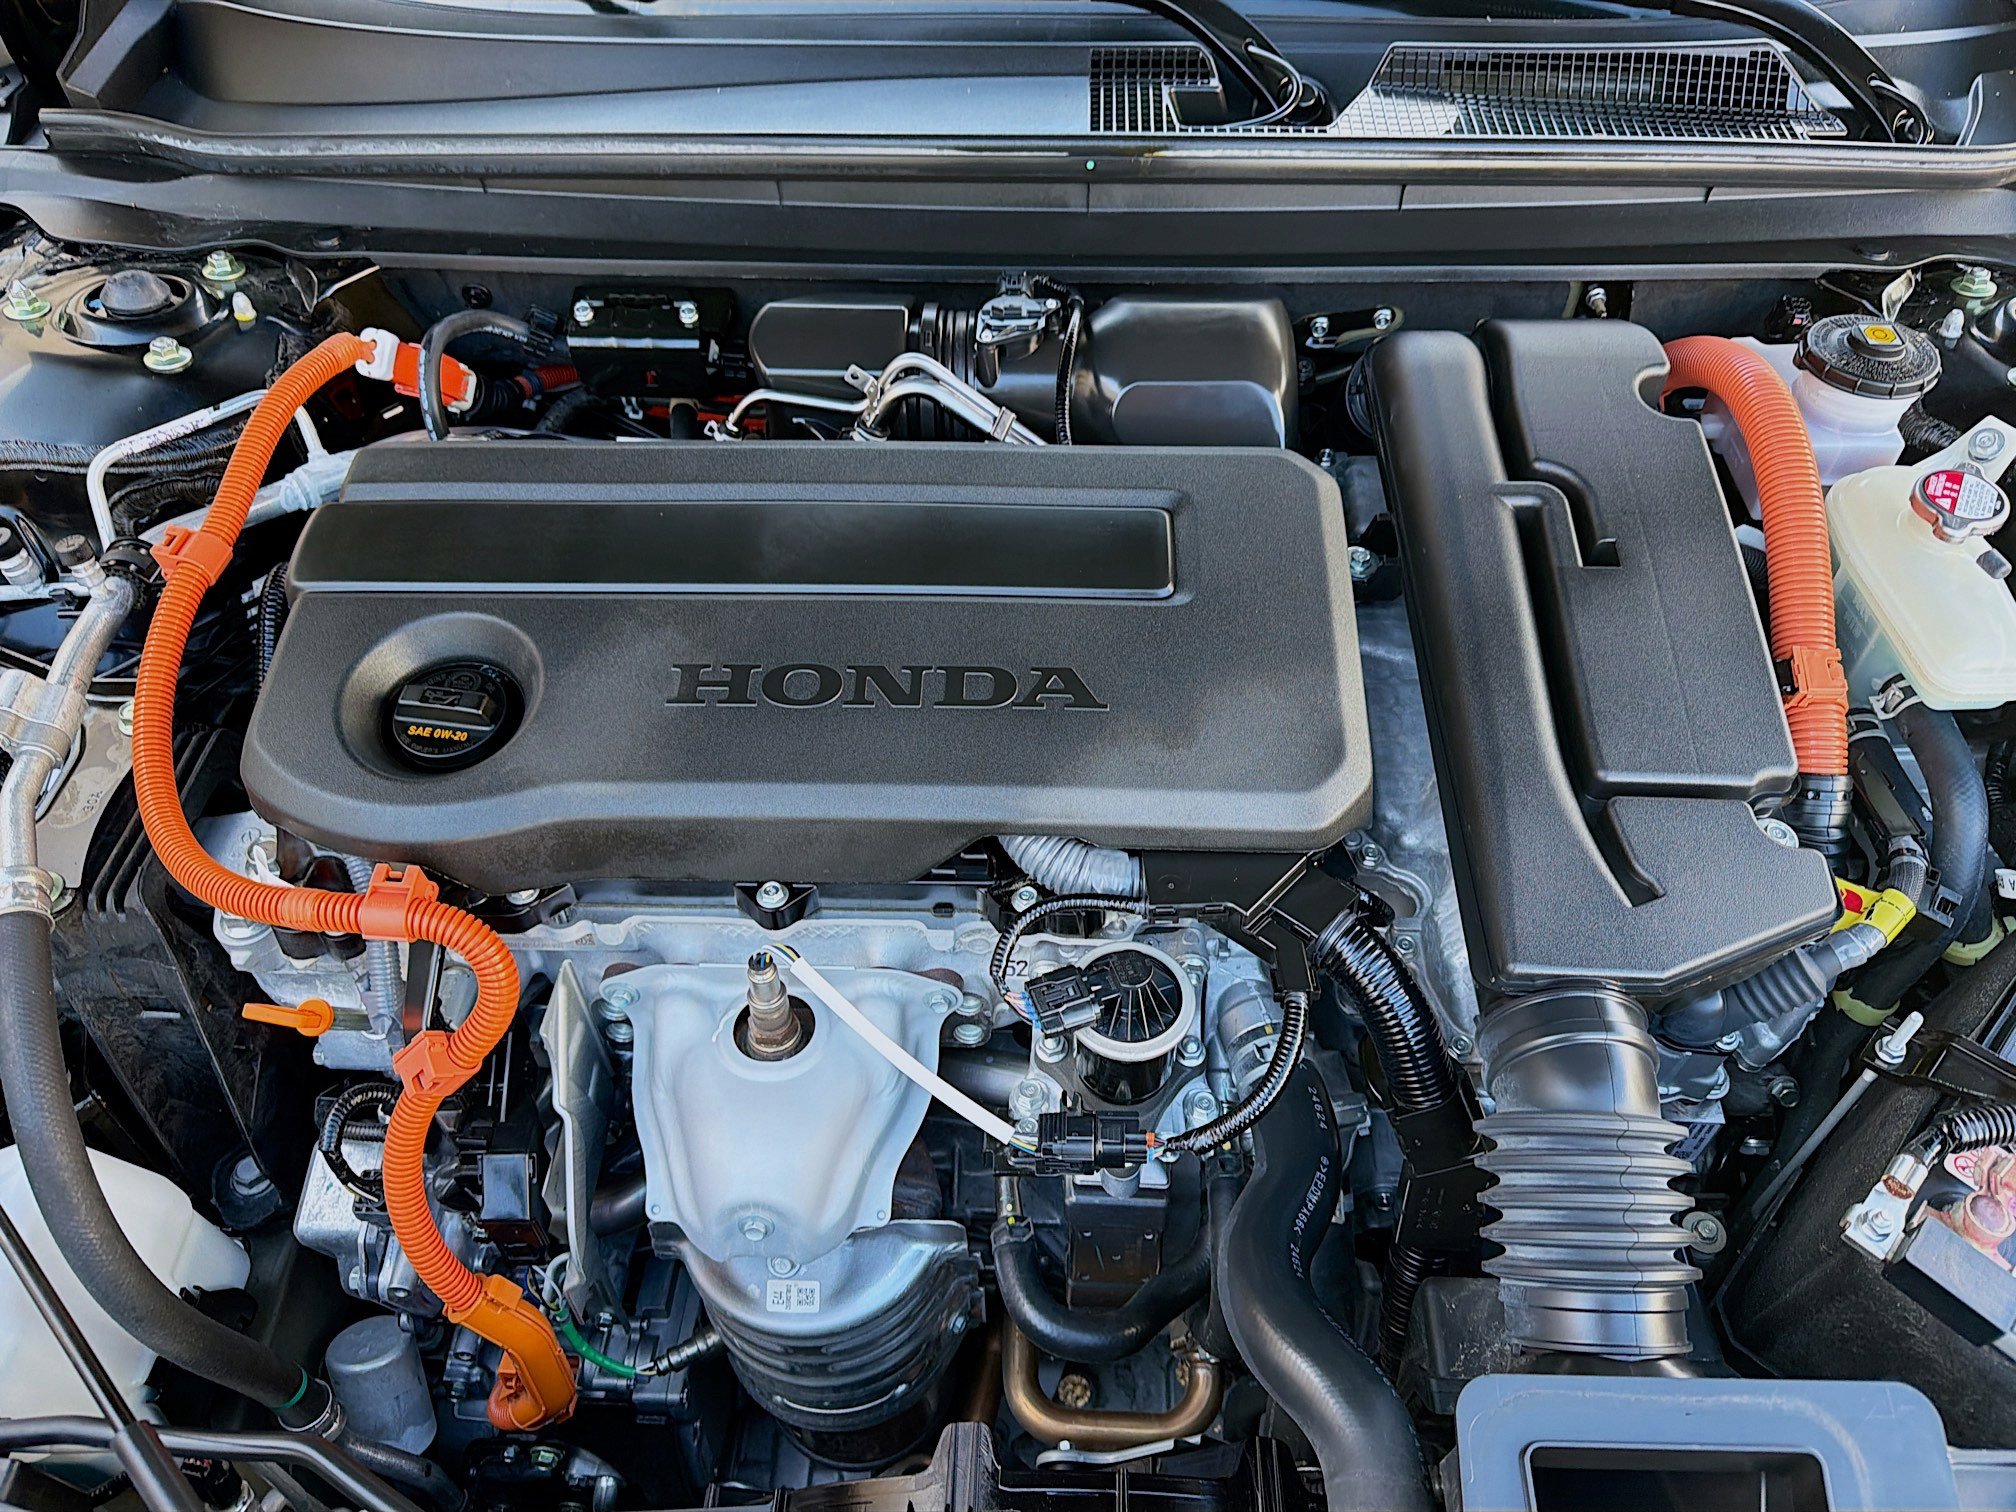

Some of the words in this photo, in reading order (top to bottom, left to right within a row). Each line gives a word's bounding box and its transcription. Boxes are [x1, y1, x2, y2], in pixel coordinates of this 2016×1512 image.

[665, 663, 1110, 712] HONDA
[407, 725, 433, 738] SAE
[433, 728, 468, 742] 0W-20
